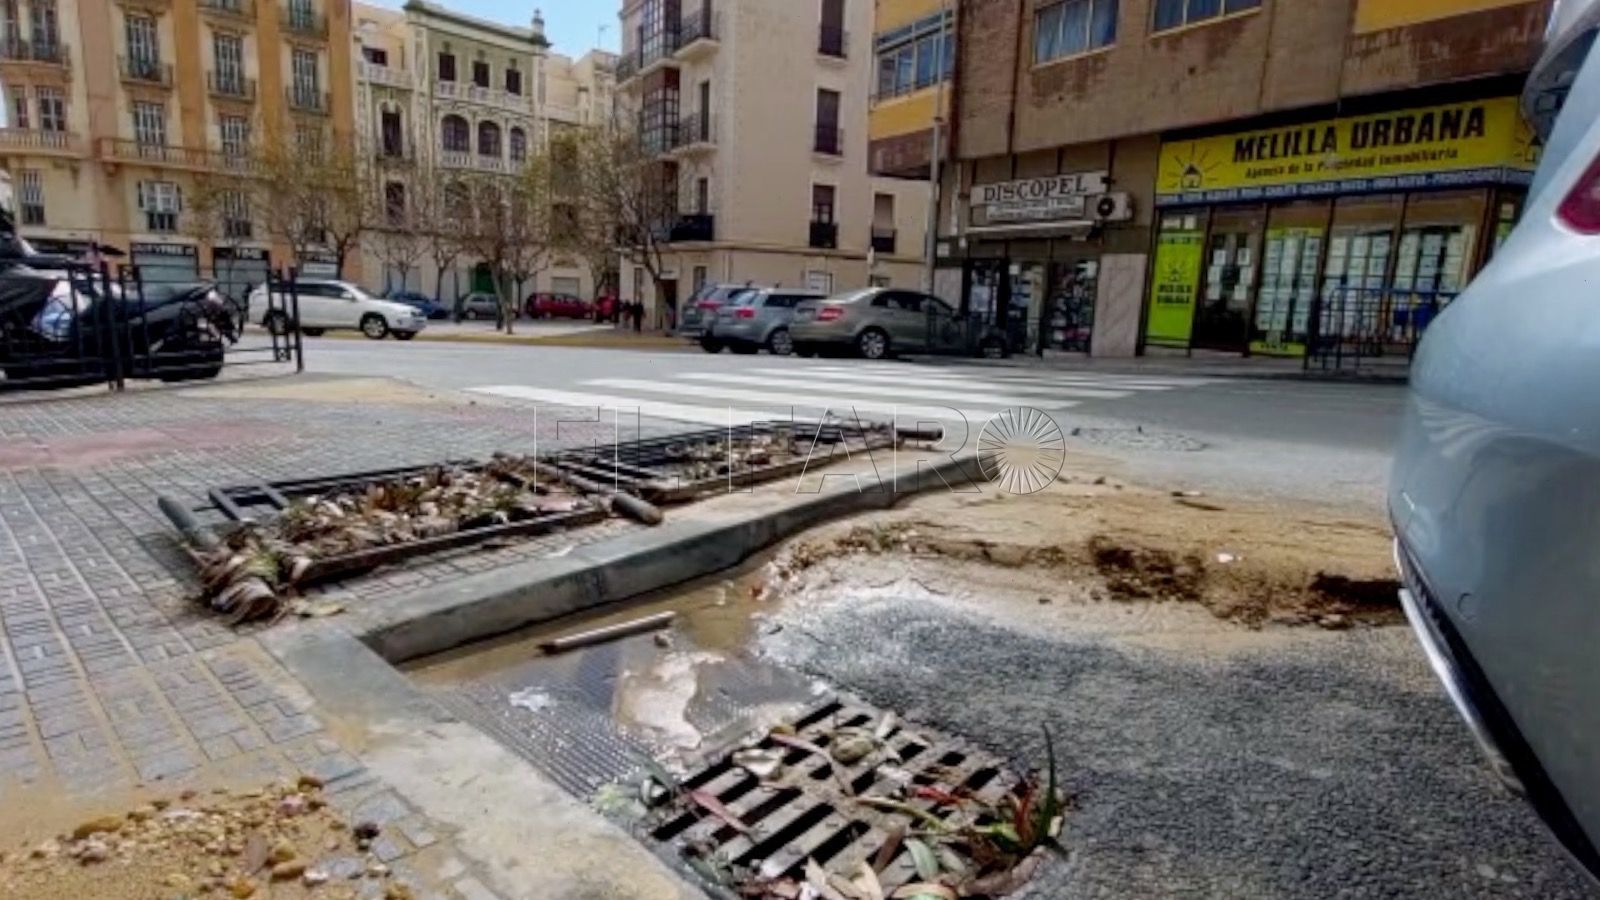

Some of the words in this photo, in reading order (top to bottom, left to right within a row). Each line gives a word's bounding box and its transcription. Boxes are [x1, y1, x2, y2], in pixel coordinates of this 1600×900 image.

[1233, 126, 1337, 162] MELILLA
[1350, 106, 1485, 150] URBANA
[1288, 164, 1299, 174] de
[1304, 161, 1313, 172] la
[984, 175, 1088, 201] DISCOPEL
